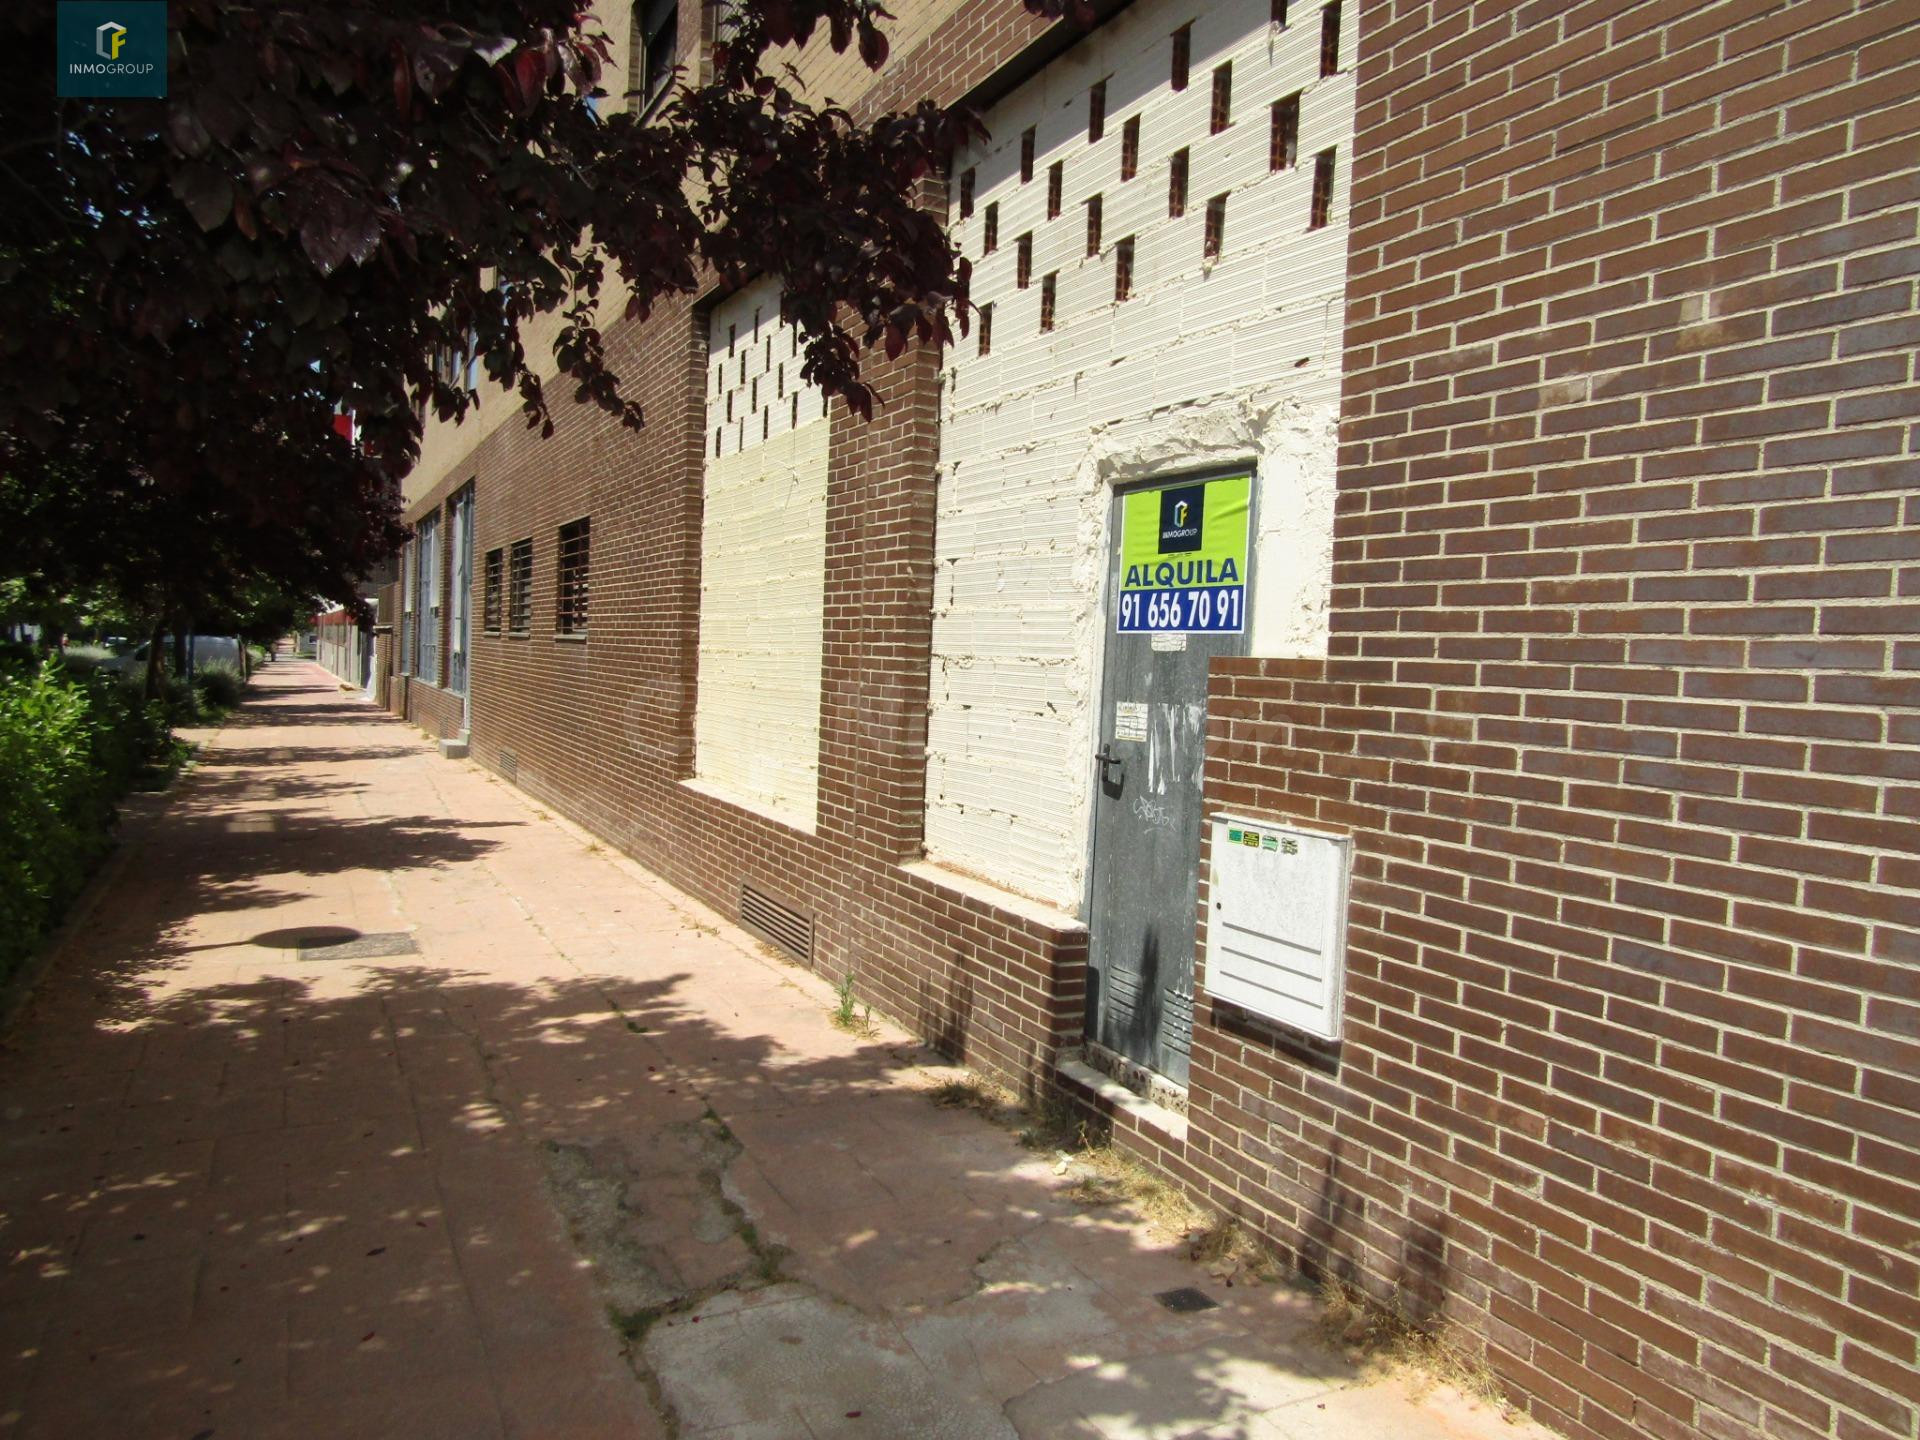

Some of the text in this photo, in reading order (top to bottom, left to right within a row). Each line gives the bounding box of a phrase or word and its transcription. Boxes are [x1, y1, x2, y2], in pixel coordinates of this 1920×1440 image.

[1126, 559, 1238, 587] ALQUILA
[1122, 589, 1239, 628] 91 656 70 91
